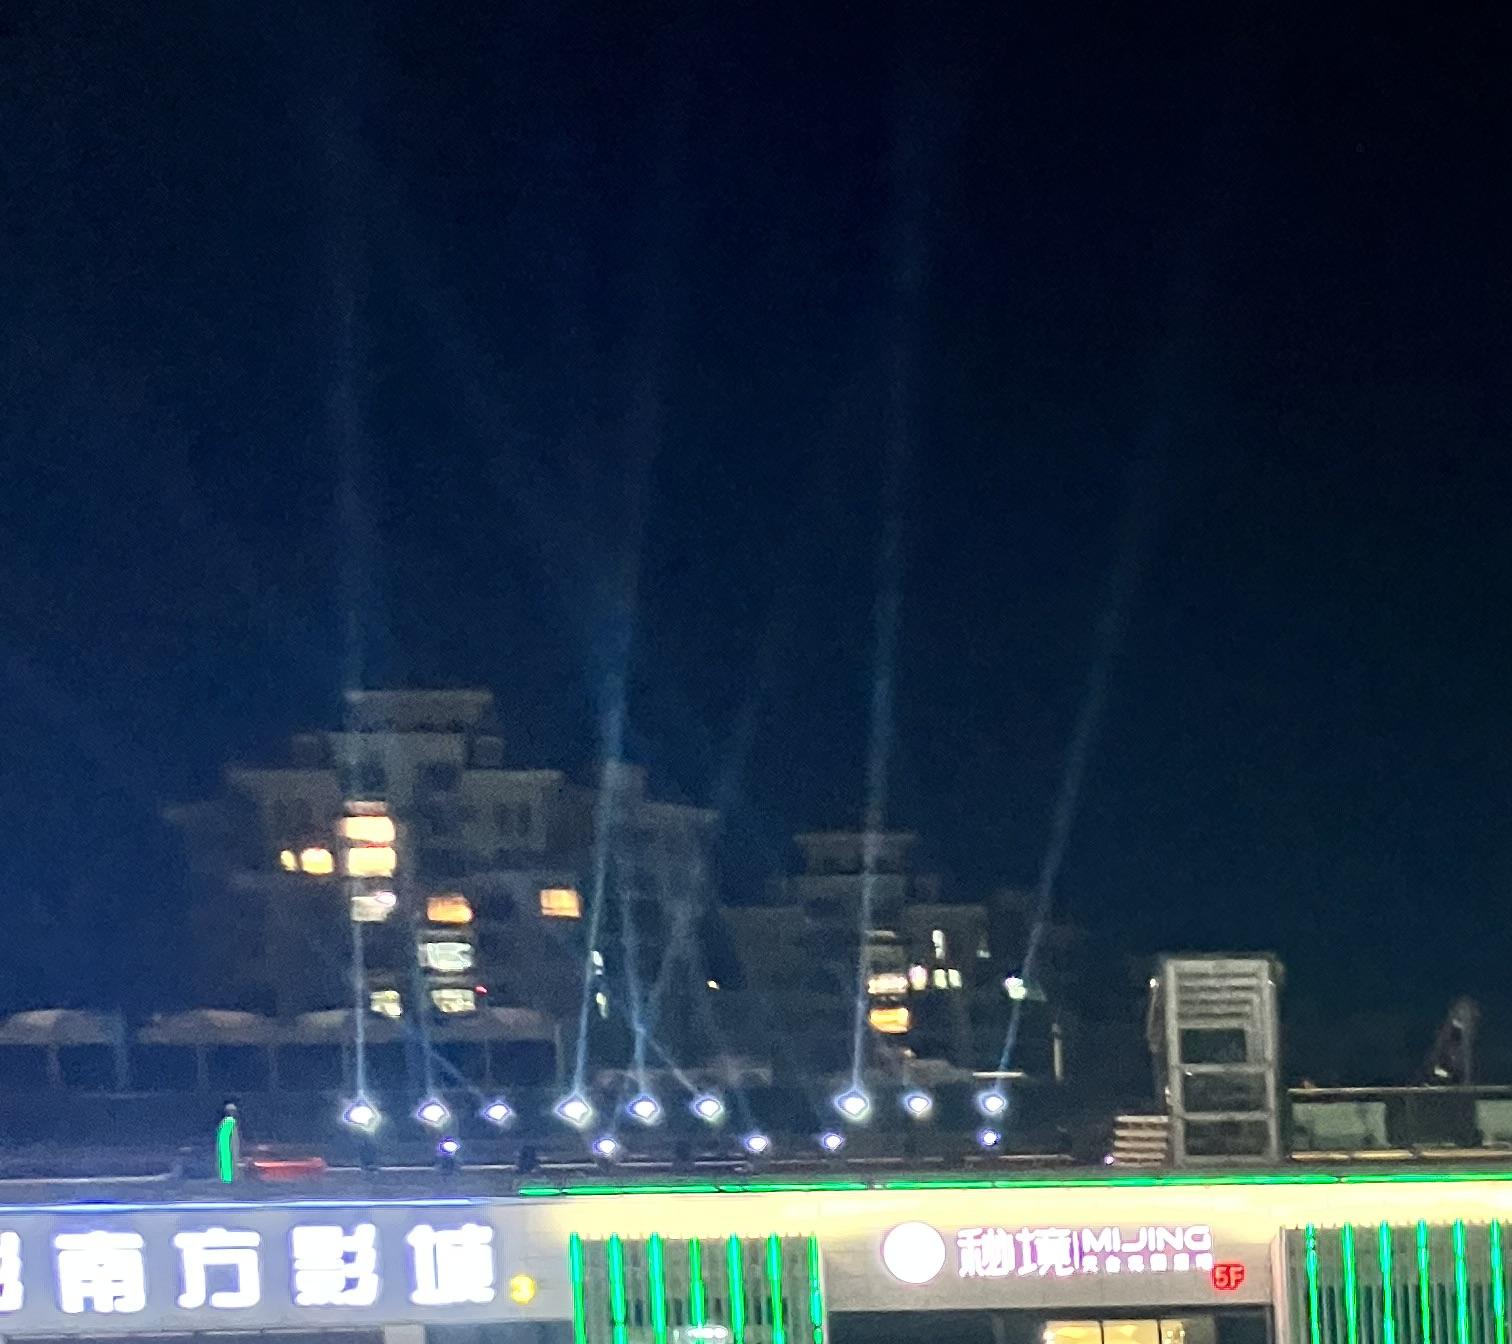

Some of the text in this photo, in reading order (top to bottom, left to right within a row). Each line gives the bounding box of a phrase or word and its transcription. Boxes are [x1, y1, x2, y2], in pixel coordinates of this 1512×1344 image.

[956, 1227, 1077, 1278] 秘境
[1081, 1225, 1213, 1253] MIJING
[1213, 1263, 1245, 1291] 5F
